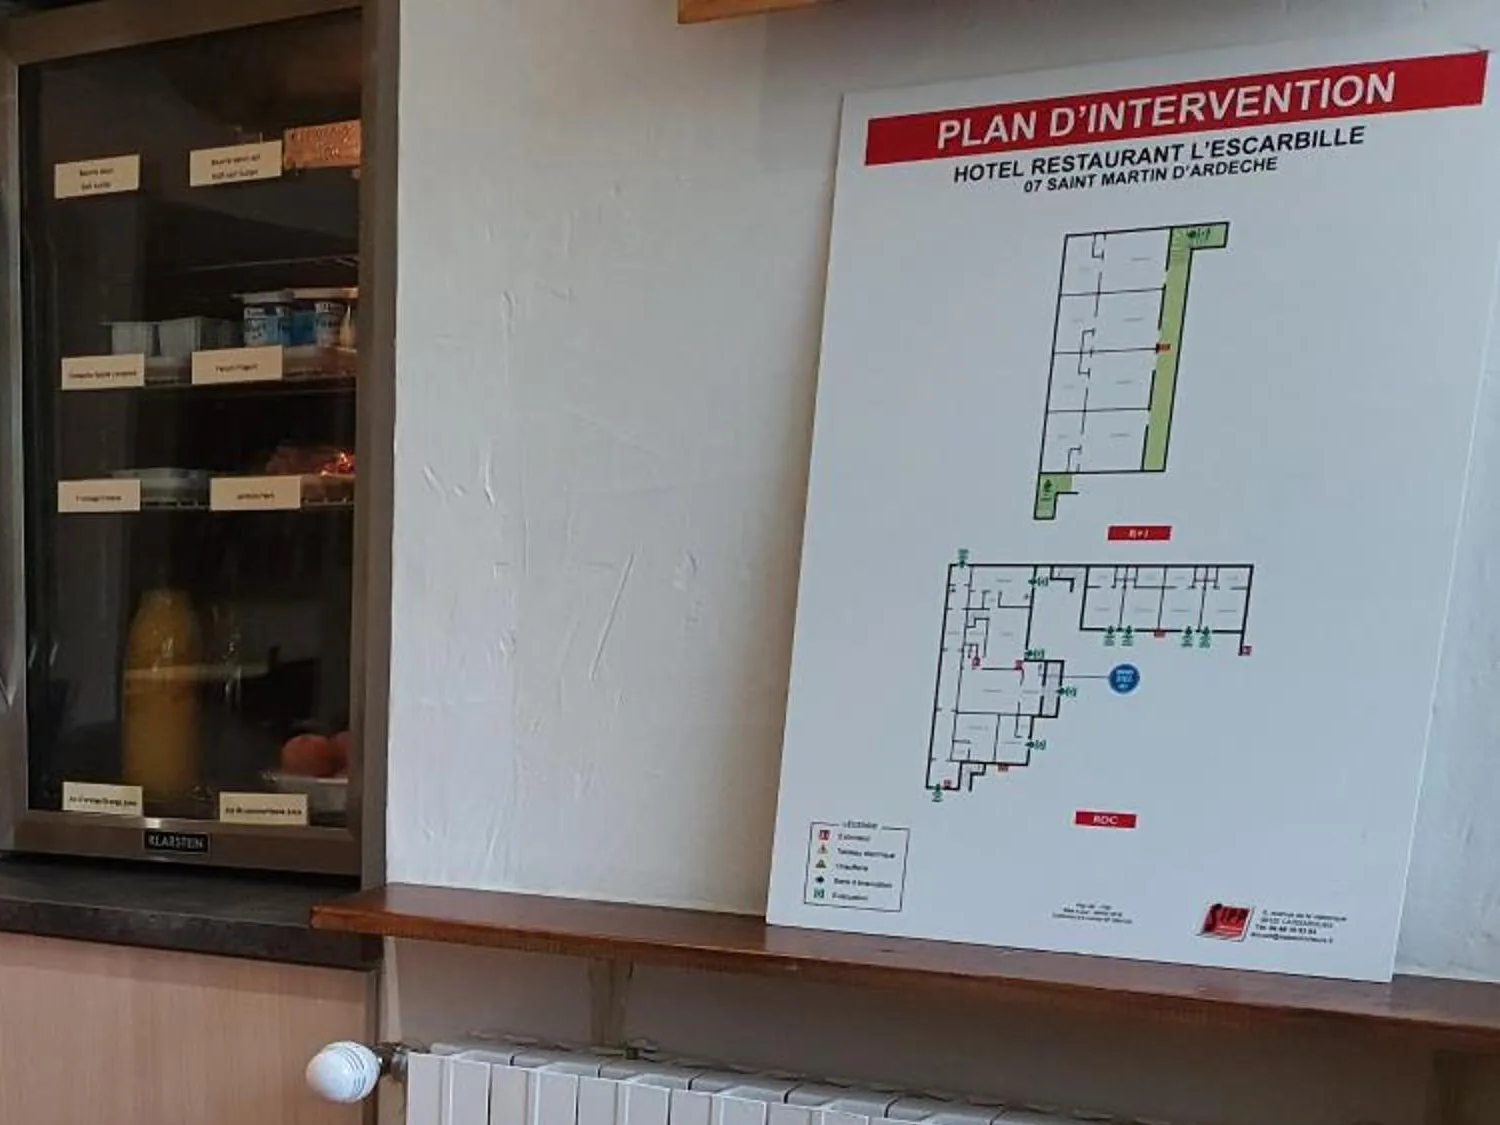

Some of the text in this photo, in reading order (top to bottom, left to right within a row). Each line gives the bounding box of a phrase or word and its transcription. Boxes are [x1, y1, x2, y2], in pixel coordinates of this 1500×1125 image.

[936, 71, 1396, 150] PLAN D'INTERVENTION
[953, 125, 1366, 183] HOTEL RESTAURANT L'ESCARBILLE
[1023, 156, 1279, 193] 07 SAINT MARTIN D'ARDECHE
[1093, 815, 1119, 825] RDC
